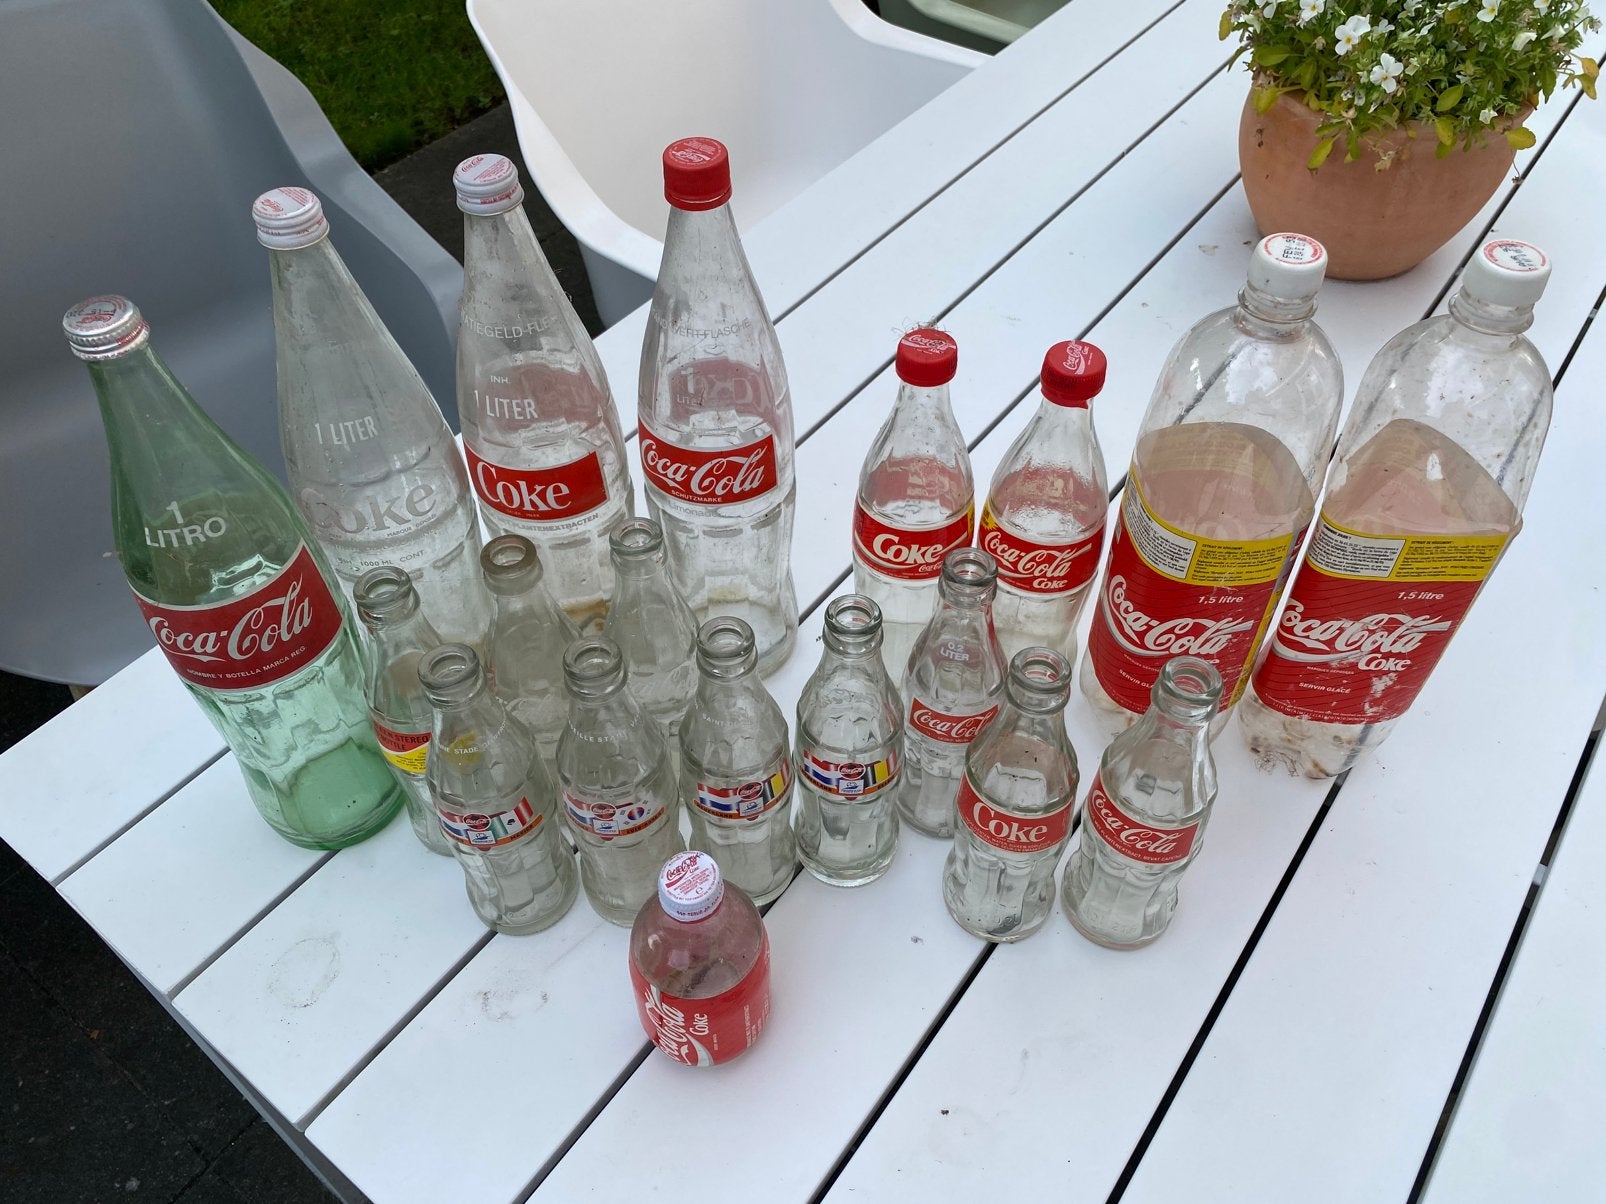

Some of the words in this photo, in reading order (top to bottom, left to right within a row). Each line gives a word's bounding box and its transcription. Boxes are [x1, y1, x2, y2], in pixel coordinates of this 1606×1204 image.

[474, 389, 480, 409] 1
[485, 395, 538, 420] LITER
[315, 422, 323, 445] 1
[330, 415, 378, 446] LITER
[641, 438, 767, 495] Coca-Cola
[476, 461, 571, 511] Coke
[671, 489, 722, 502] SCHUTZMARKE
[167, 501, 185, 525] 1
[144, 516, 228, 549] LITRO
[872, 533, 944, 565] Coke
[985, 531, 1078, 578] Coca-Cola
[1032, 577, 1068, 589] Coke
[1398, 591, 1415, 600] 1,5
[1418, 590, 1444, 600] litre
[1199, 596, 1216, 604] 1,5
[1219, 595, 1244, 604] litre
[149, 572, 313, 662] Coca-Cola
[1109, 574, 1243, 655] Coca-Cola
[1278, 597, 1441, 654] Coca-Cola
[225, 667, 262, 679] BOTELLA
[263, 654, 290, 672] MARCA
[940, 646, 970, 661] LITER
[1358, 653, 1412, 671] Coke
[1119, 669, 1141, 685] SERVIR
[1298, 681, 1326, 691] SERVIR
[913, 709, 994, 738] Coca-Col
[454, 746, 480, 755] STADE
[973, 801, 1048, 843] Coke
[1092, 789, 1184, 853] Coca-Cola
[689, 1013, 709, 1037] Coke
